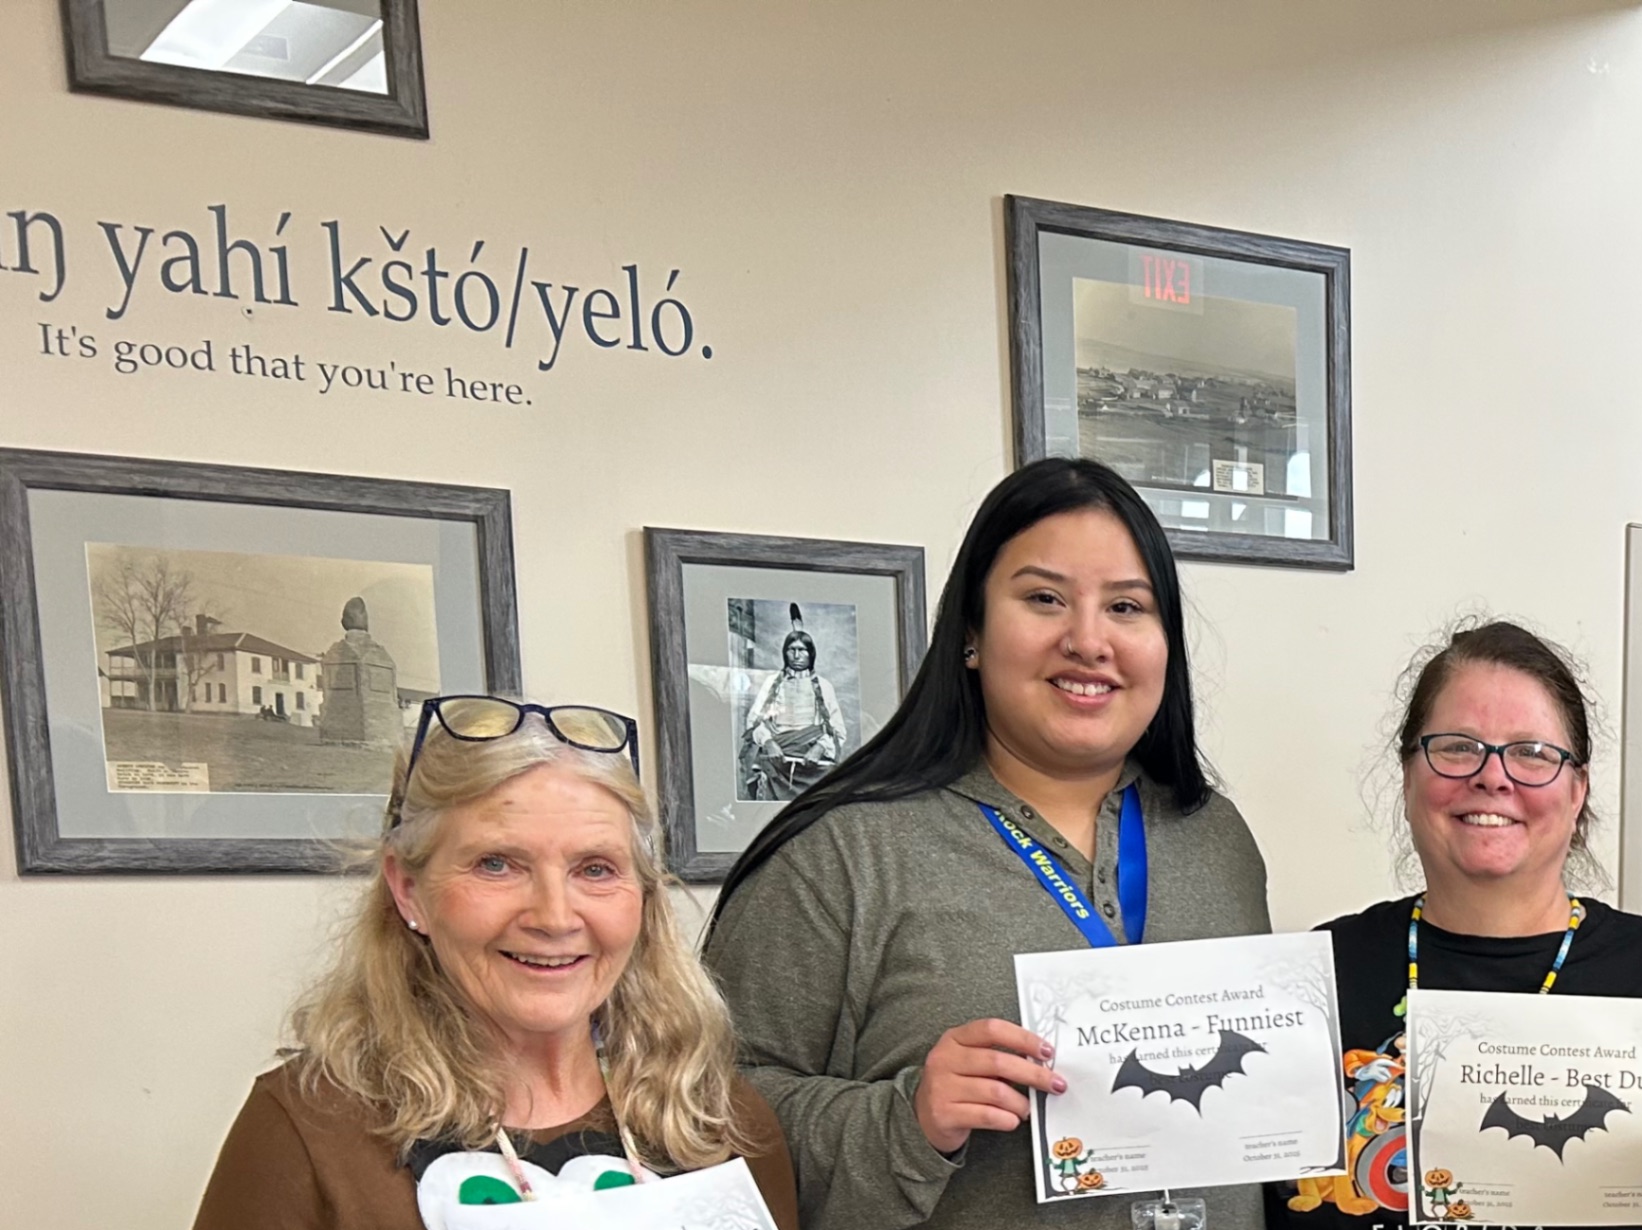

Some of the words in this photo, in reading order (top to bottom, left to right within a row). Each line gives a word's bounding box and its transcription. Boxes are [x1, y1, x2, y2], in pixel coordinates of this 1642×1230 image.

[321, 220, 713, 372] kštó/yeló.
[38, 322, 97, 358] It's
[113, 339, 215, 374] good
[229, 344, 305, 381] that
[317, 361, 435, 394] you're
[444, 367, 533, 406] here.
[994, 811, 1033, 849] ock
[1030, 850, 1090, 919] Warriors
[1099, 996, 1162, 1013] Costume
[1164, 991, 1218, 1006] Contest
[1221, 985, 1264, 1002] Award
[1077, 1021, 1186, 1046] McKenna
[1206, 1008, 1304, 1034] Funniest
[1138, 1047, 1169, 1061] arned
[1172, 1047, 1192, 1059] this
[1478, 1041, 1537, 1056] Costume
[1540, 1044, 1591, 1057] Contest
[1593, 1046, 1636, 1059] Award
[1460, 1064, 1545, 1086] Richelle
[1566, 1068, 1613, 1088] Best
[1507, 1095, 1536, 1106] arned
[1539, 1096, 1559, 1107] this
